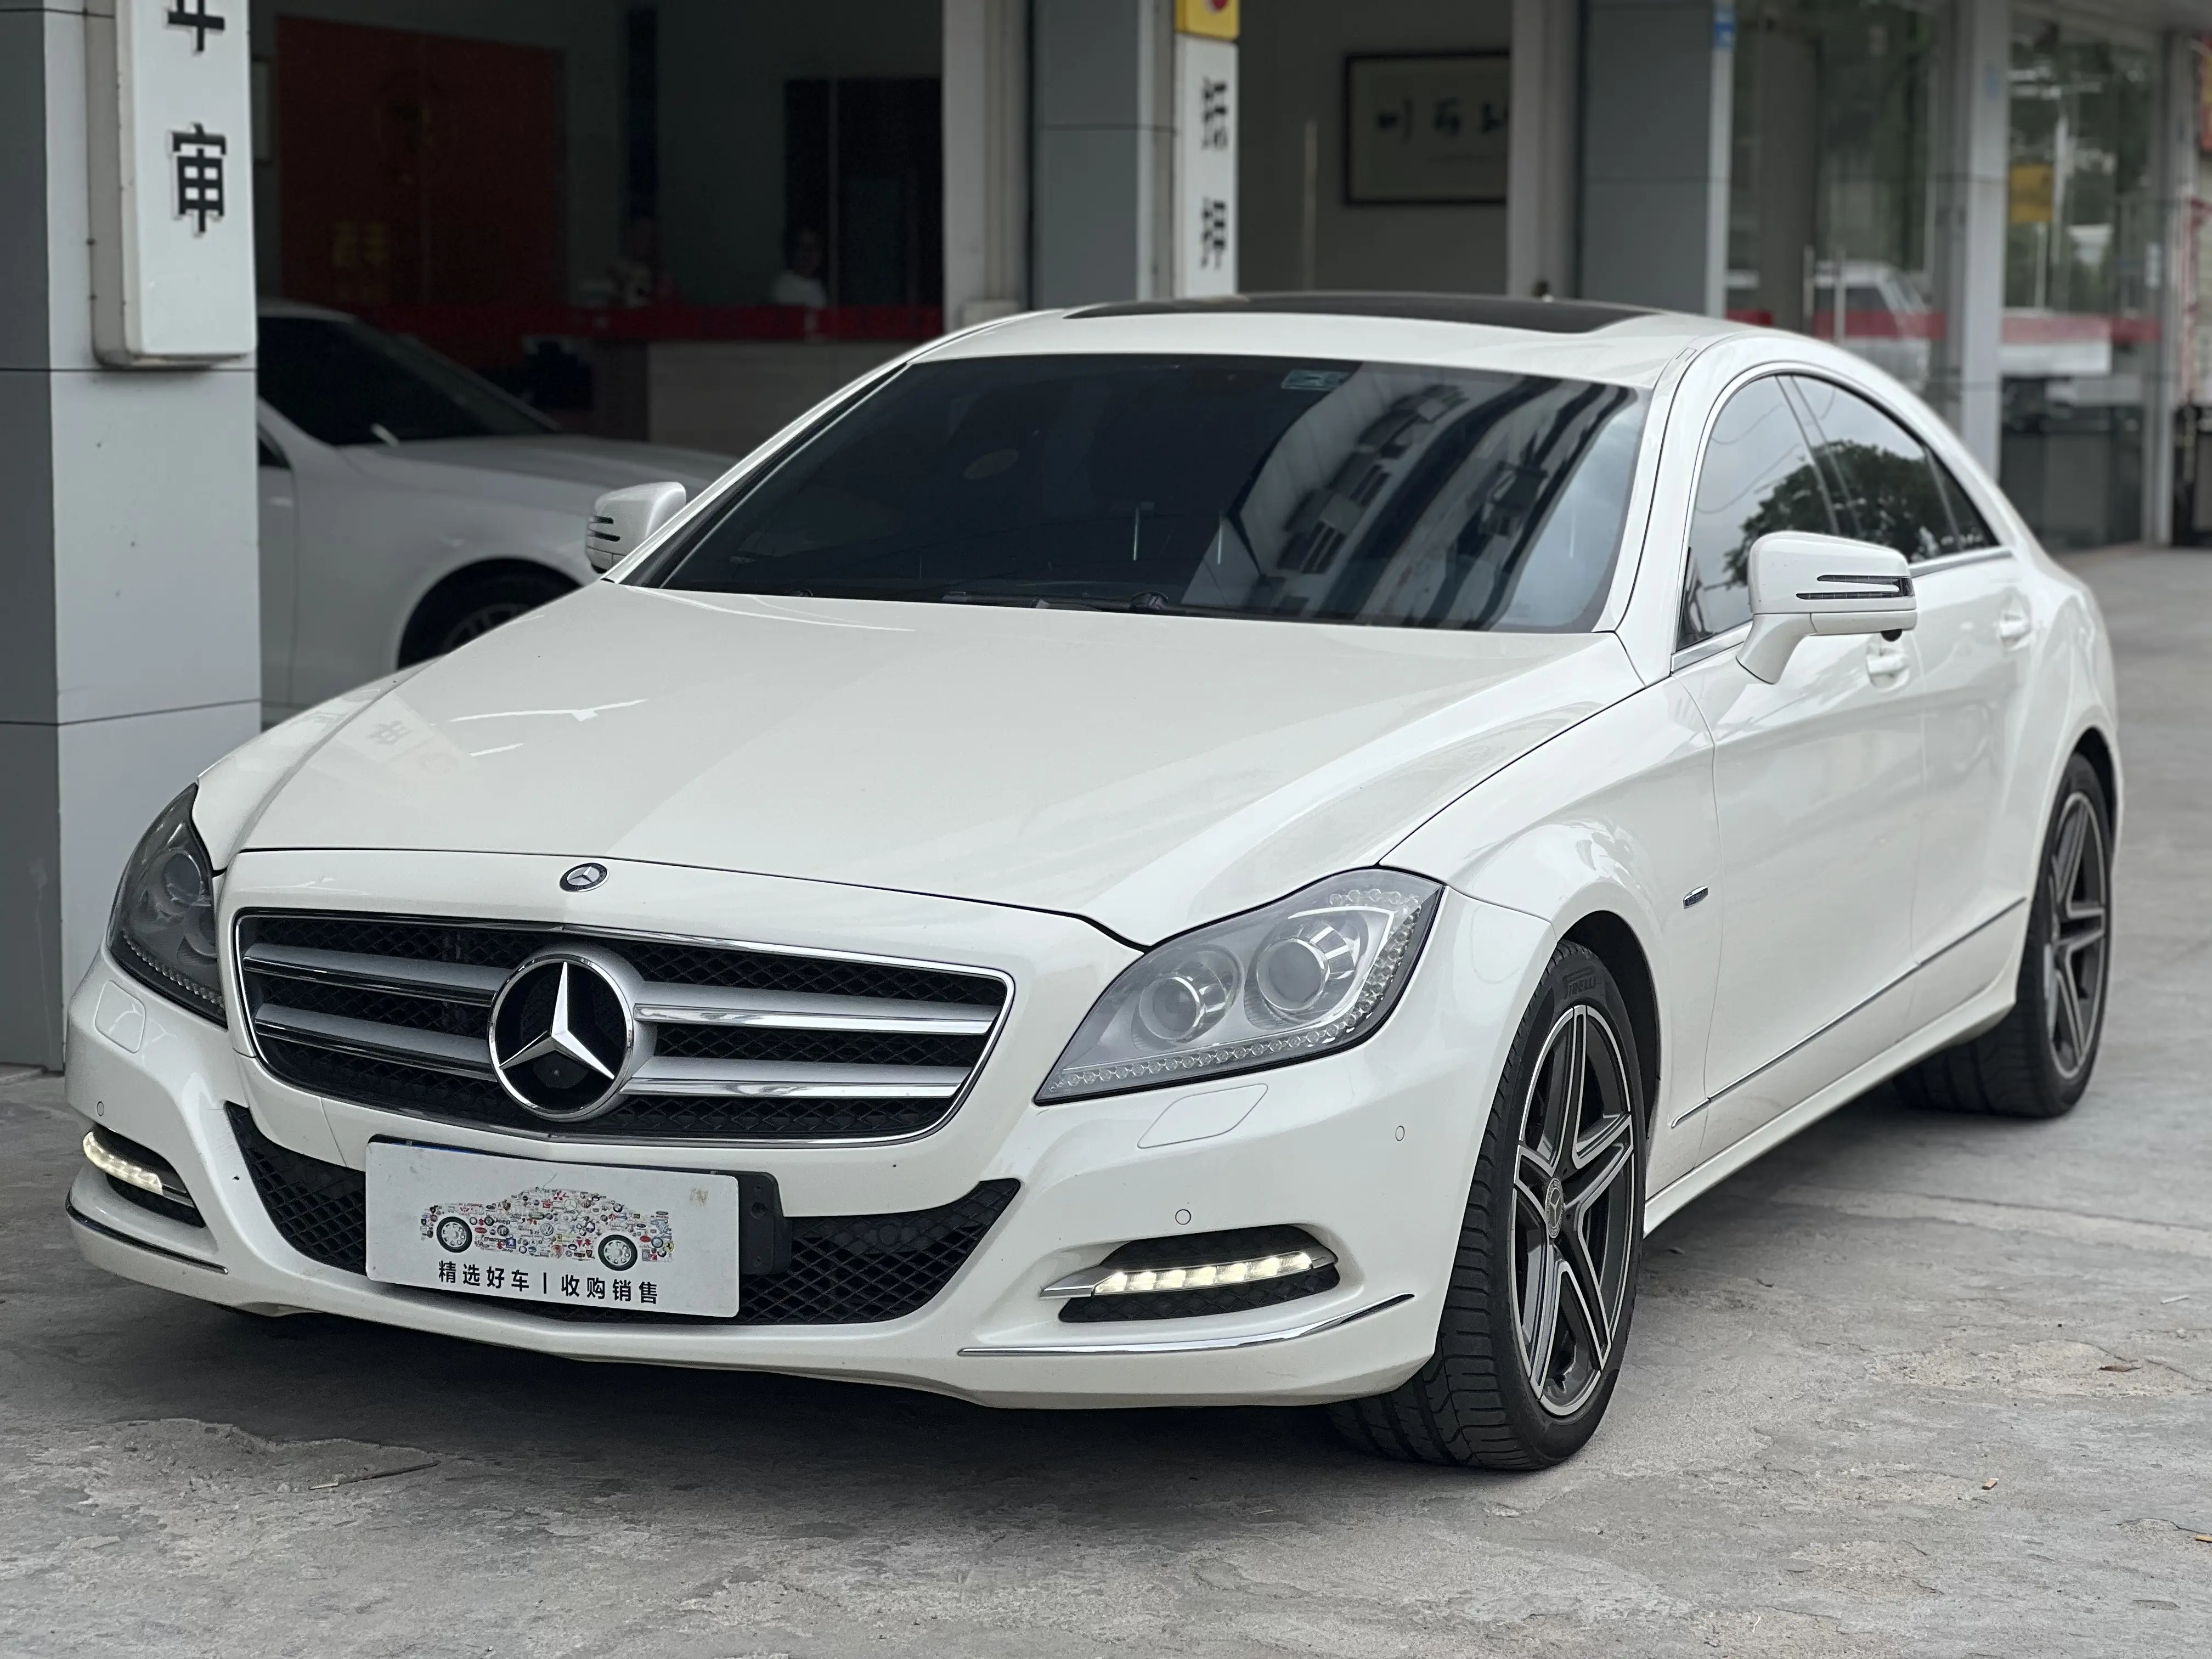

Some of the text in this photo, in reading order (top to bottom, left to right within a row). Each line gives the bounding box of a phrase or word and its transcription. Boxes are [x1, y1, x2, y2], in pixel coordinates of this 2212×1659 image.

[438, 1260, 658, 1305] 精选好车 收购销售
